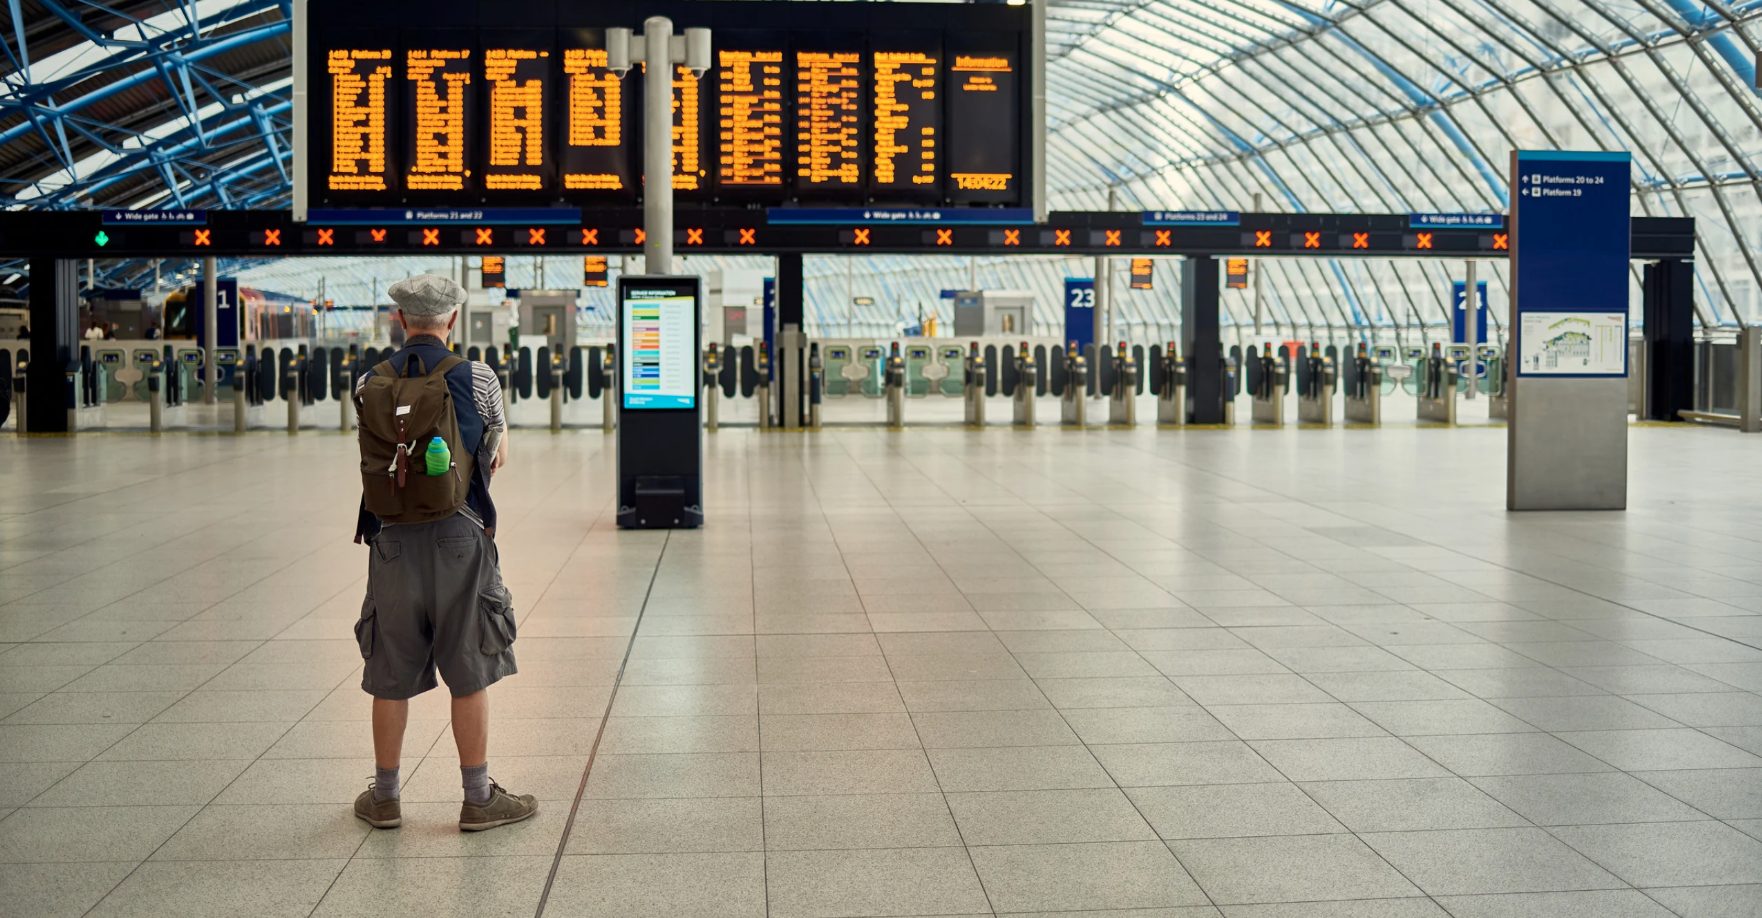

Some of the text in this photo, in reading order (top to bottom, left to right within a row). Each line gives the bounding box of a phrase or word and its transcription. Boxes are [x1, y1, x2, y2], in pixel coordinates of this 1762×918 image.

[956, 56, 1008, 67] Information
[1543, 175, 1604, 184] Platforms 20 to 24
[1543, 188, 1582, 196] Platform 19
[125, 212, 159, 221] Wide gate
[417, 211, 449, 219] Platforms
[460, 211, 472, 219] and
[218, 289, 230, 309] 1
[1071, 288, 1095, 308] 23
